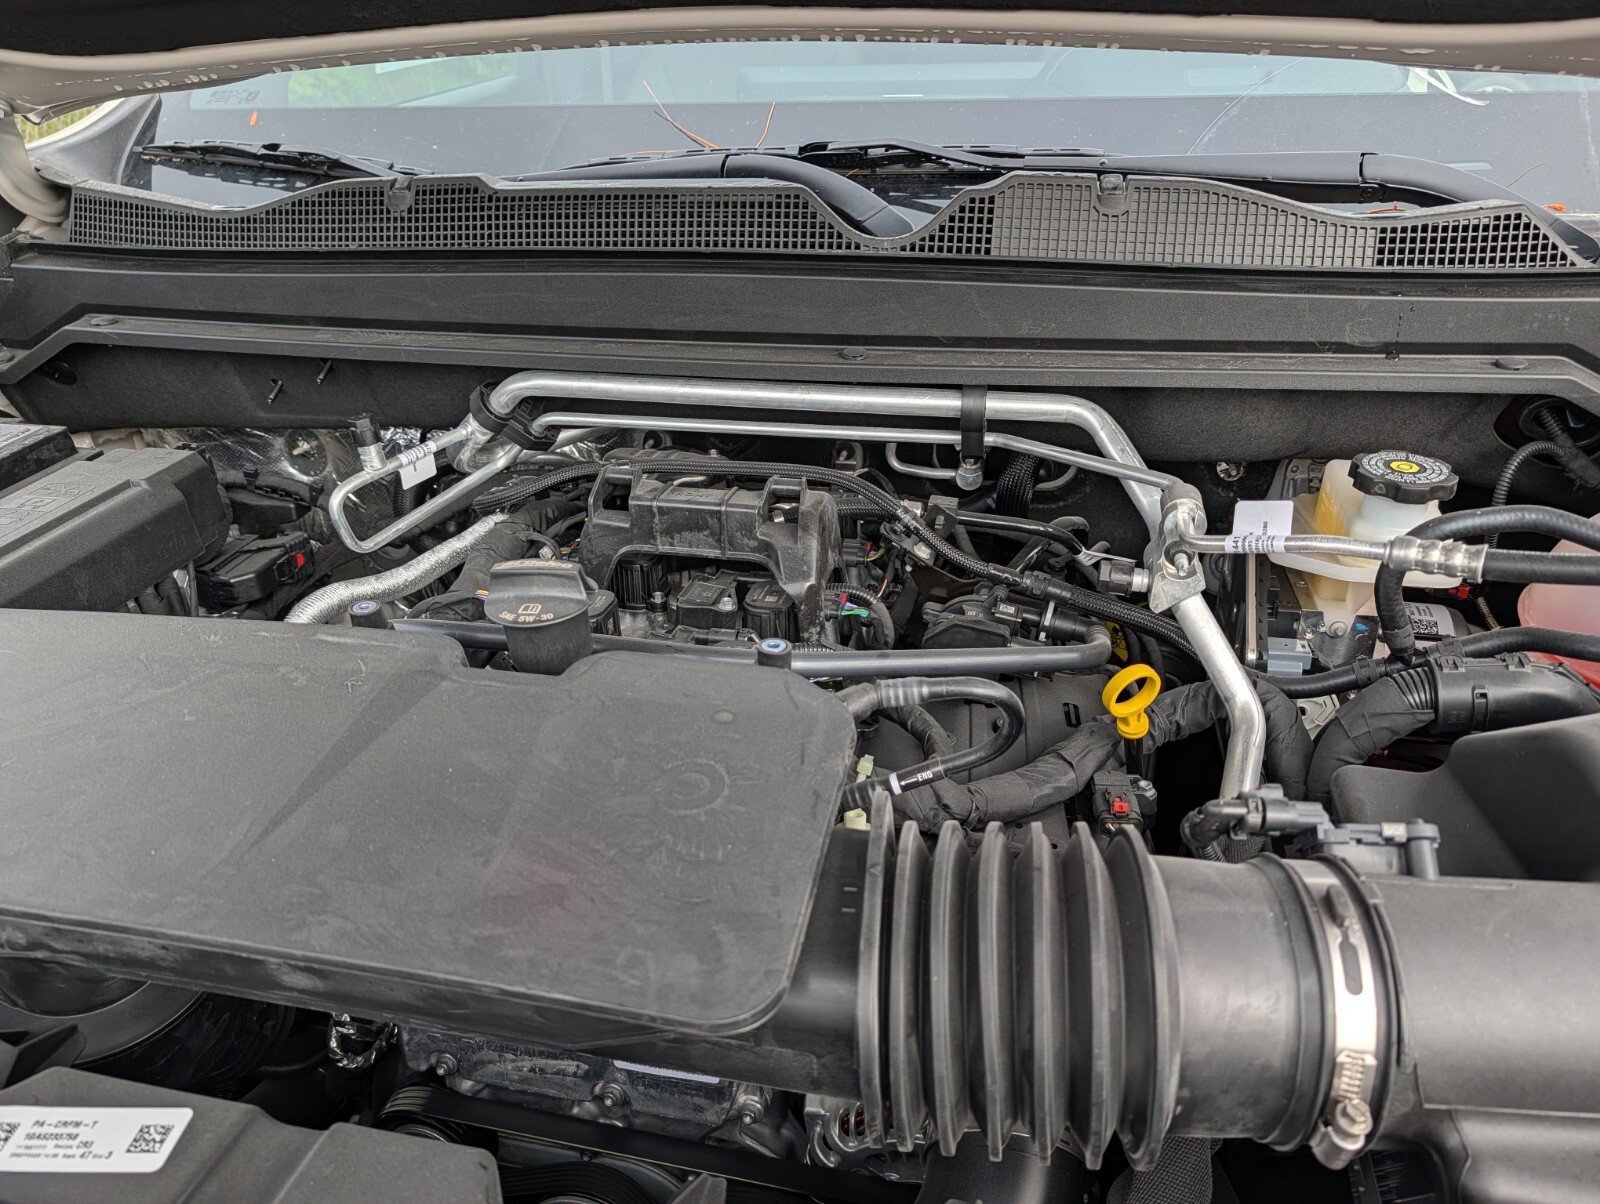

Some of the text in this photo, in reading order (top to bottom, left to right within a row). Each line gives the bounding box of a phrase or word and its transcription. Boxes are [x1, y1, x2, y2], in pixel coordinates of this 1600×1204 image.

[499, 611, 554, 622] SAE 5W-30
[917, 770, 933, 782] ENG
